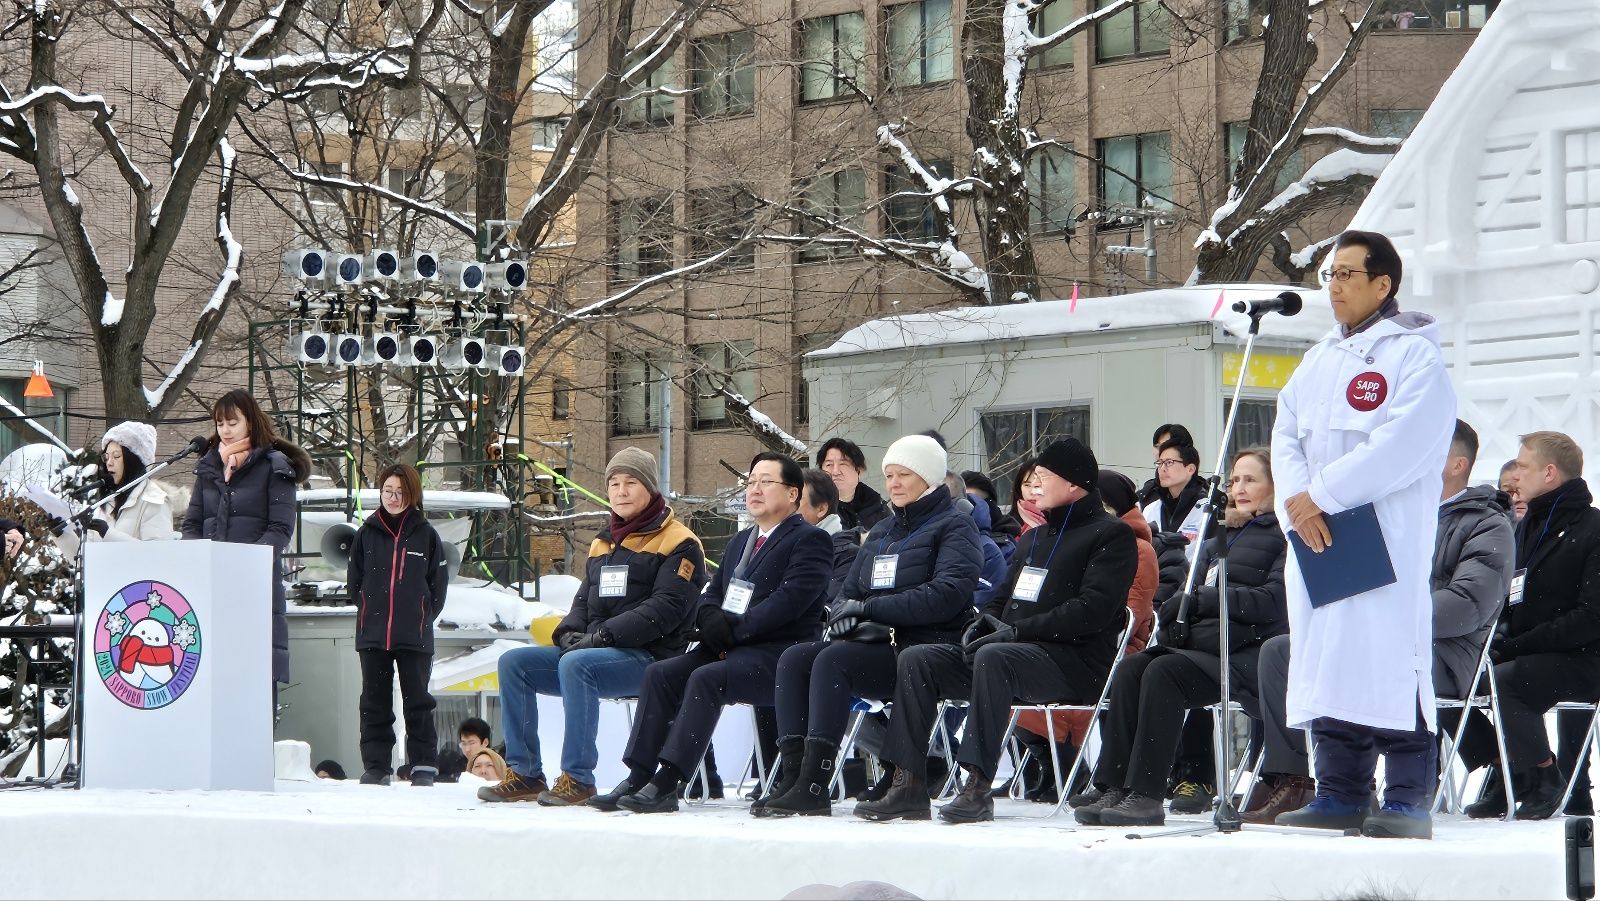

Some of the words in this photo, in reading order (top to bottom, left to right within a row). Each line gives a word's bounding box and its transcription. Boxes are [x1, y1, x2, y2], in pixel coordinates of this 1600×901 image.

[1356, 380, 1380, 391] SAPP
[1363, 391, 1378, 402] RO
[110, 676, 141, 705] SAPPORO
[146, 689, 168, 705] SNOW
[170, 656, 197, 695] FESTIVAL
